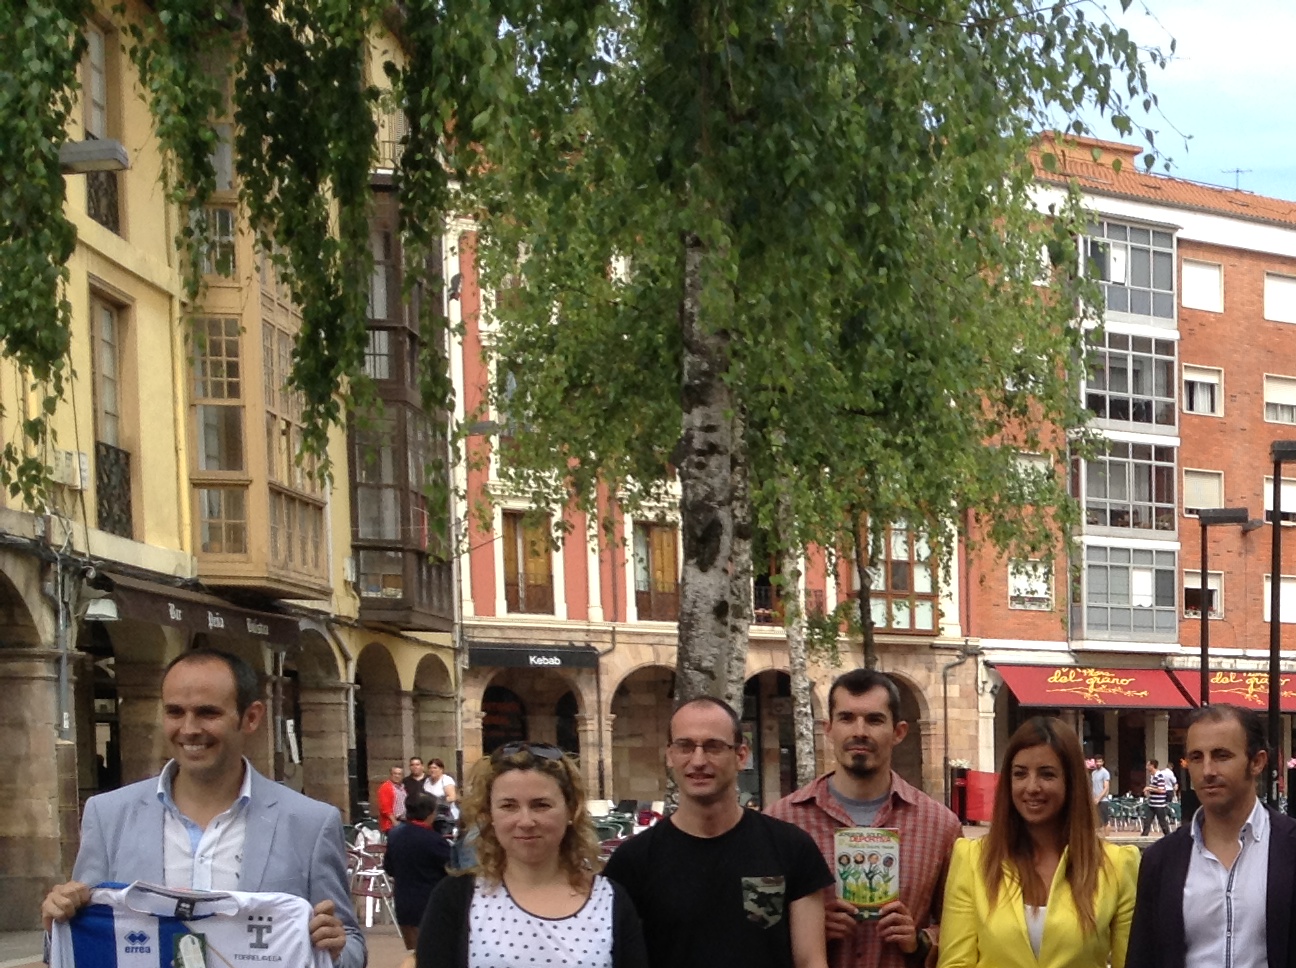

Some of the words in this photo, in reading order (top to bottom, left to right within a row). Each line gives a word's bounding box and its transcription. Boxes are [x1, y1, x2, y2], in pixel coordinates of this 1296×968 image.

[529, 655, 562, 665] Kebab
[1047, 669, 1083, 683] del
[1085, 676, 1136, 692] grano
[1210, 672, 1243, 684] del
[125, 945, 151, 953] errea
